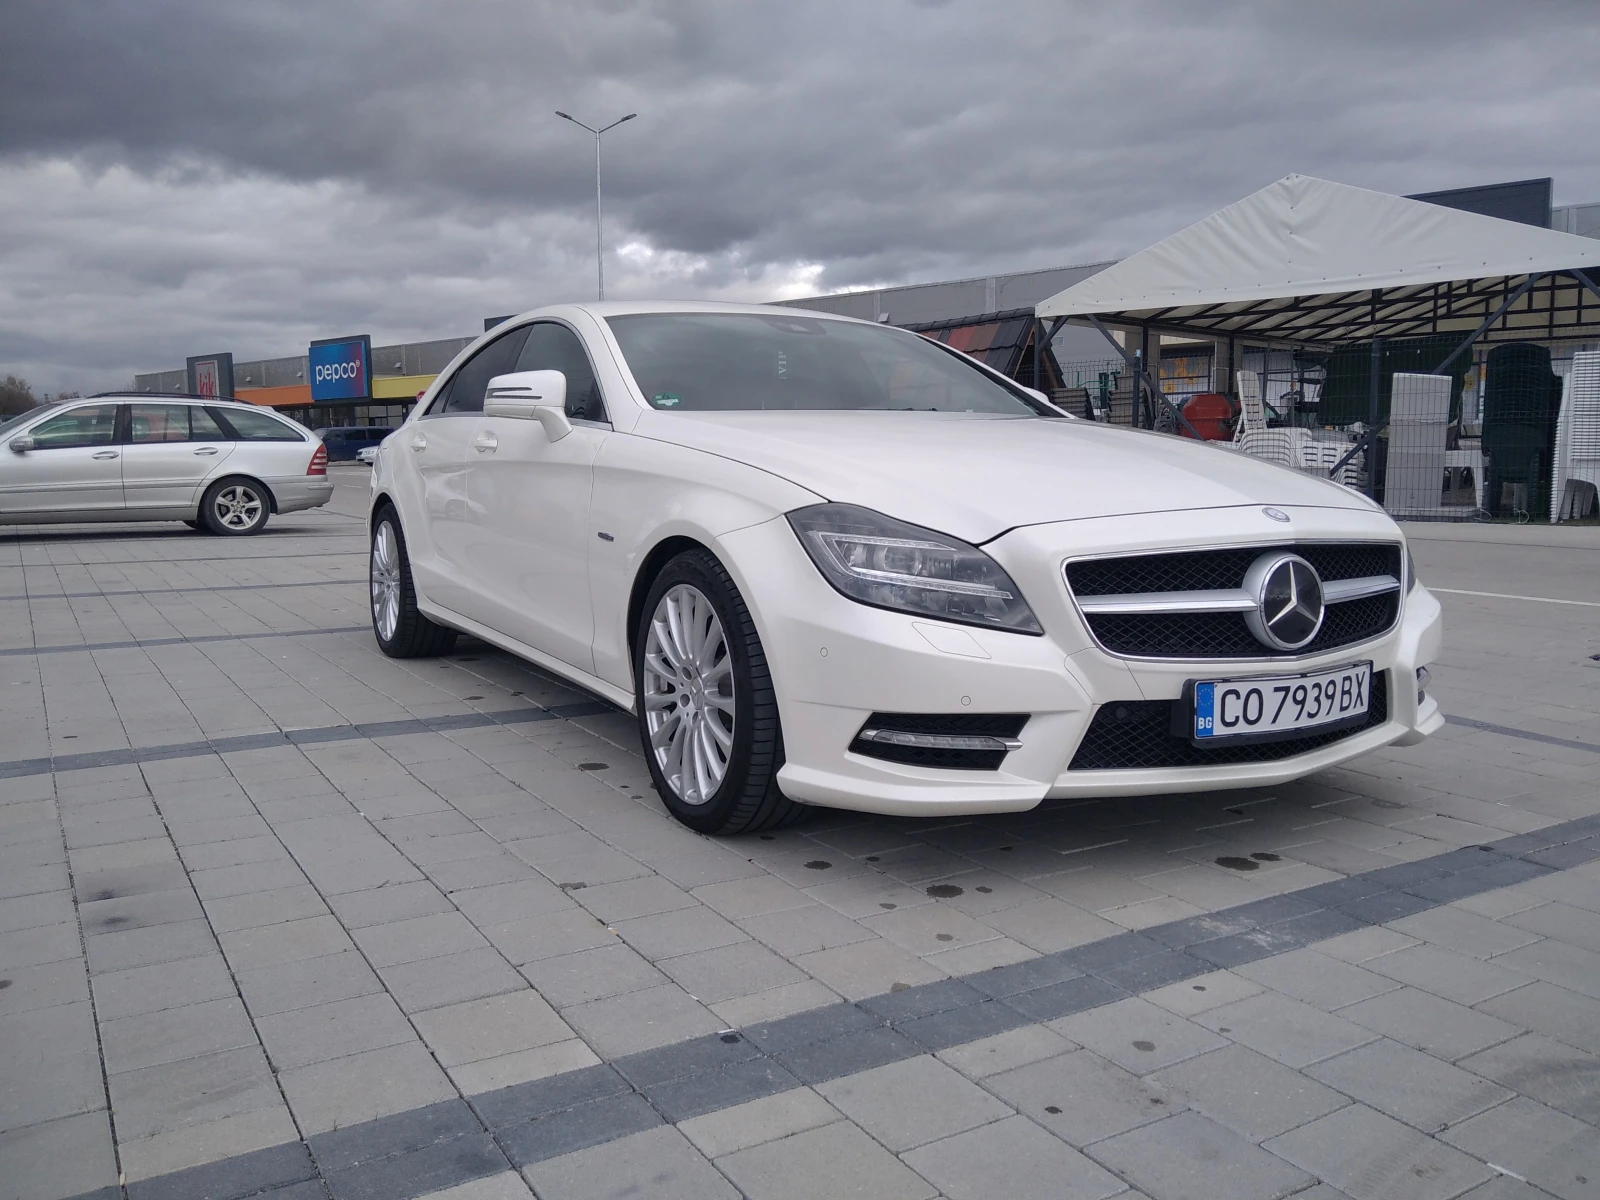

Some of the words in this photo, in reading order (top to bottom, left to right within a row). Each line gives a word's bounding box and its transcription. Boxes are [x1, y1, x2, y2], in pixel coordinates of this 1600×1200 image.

[1220, 688, 1264, 728] CO
[1270, 679, 1337, 725] 7939
[1339, 671, 1366, 712] BX
[1198, 717, 1213, 729] BG
